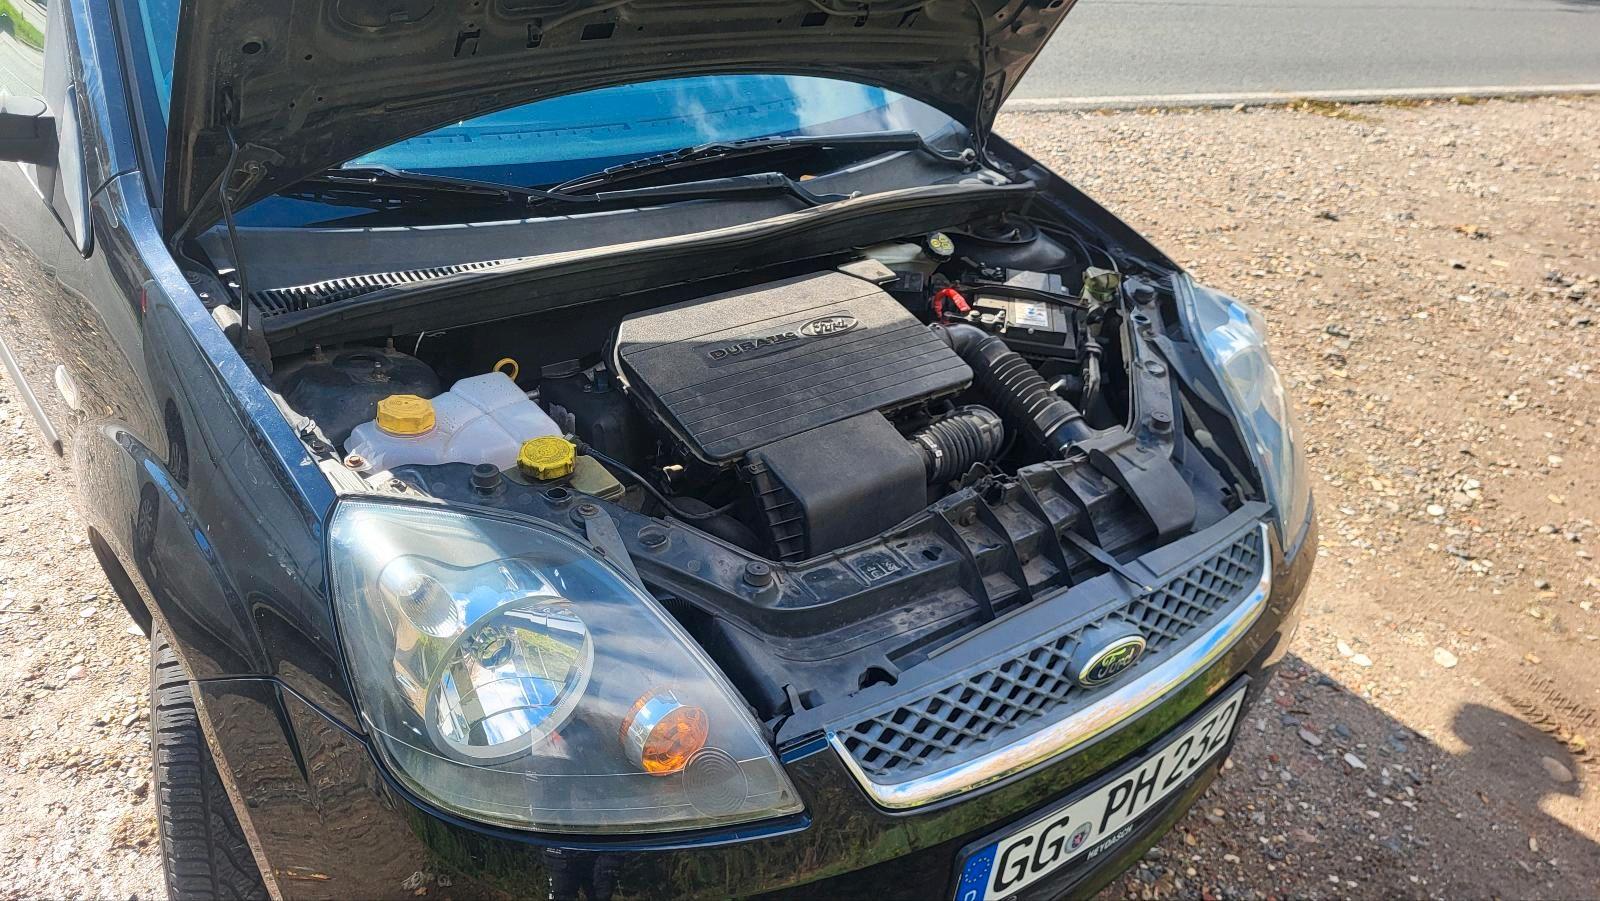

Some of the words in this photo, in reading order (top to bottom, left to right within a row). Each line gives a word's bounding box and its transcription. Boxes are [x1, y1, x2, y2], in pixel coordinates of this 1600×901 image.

[811, 318, 848, 334] Ford
[1097, 647, 1134, 679] Ford
[993, 816, 1070, 892] GG
[1098, 757, 1166, 834] PH
[1163, 700, 1238, 786] 232
